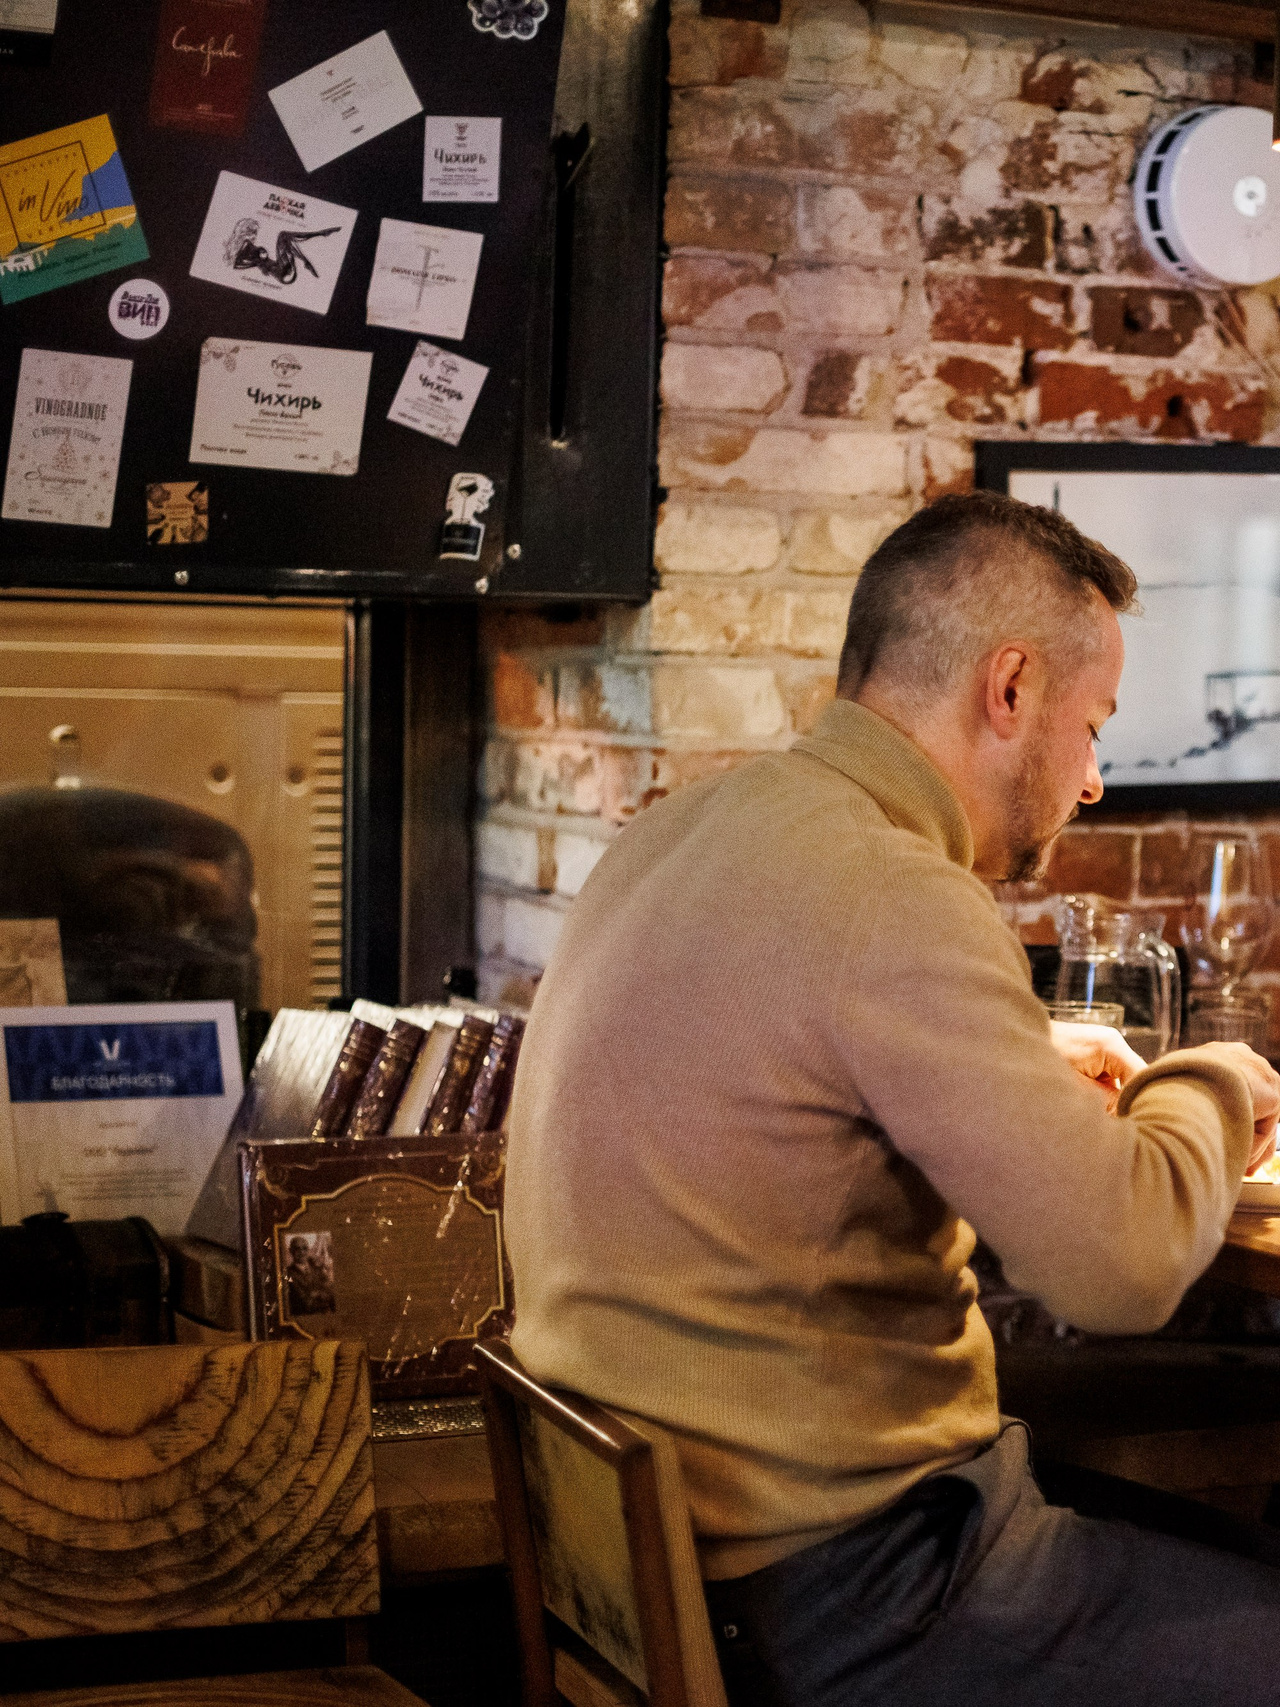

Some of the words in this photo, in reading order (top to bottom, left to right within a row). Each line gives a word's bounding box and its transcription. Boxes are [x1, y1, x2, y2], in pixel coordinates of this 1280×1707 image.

[433, 148, 488, 165] Чихирь
[35, 396, 109, 421] VINOGRADNOE
[247, 386, 323, 415] Чихирь
[50, 1072, 176, 1092] БЛАГОДАРНОСТЬ
